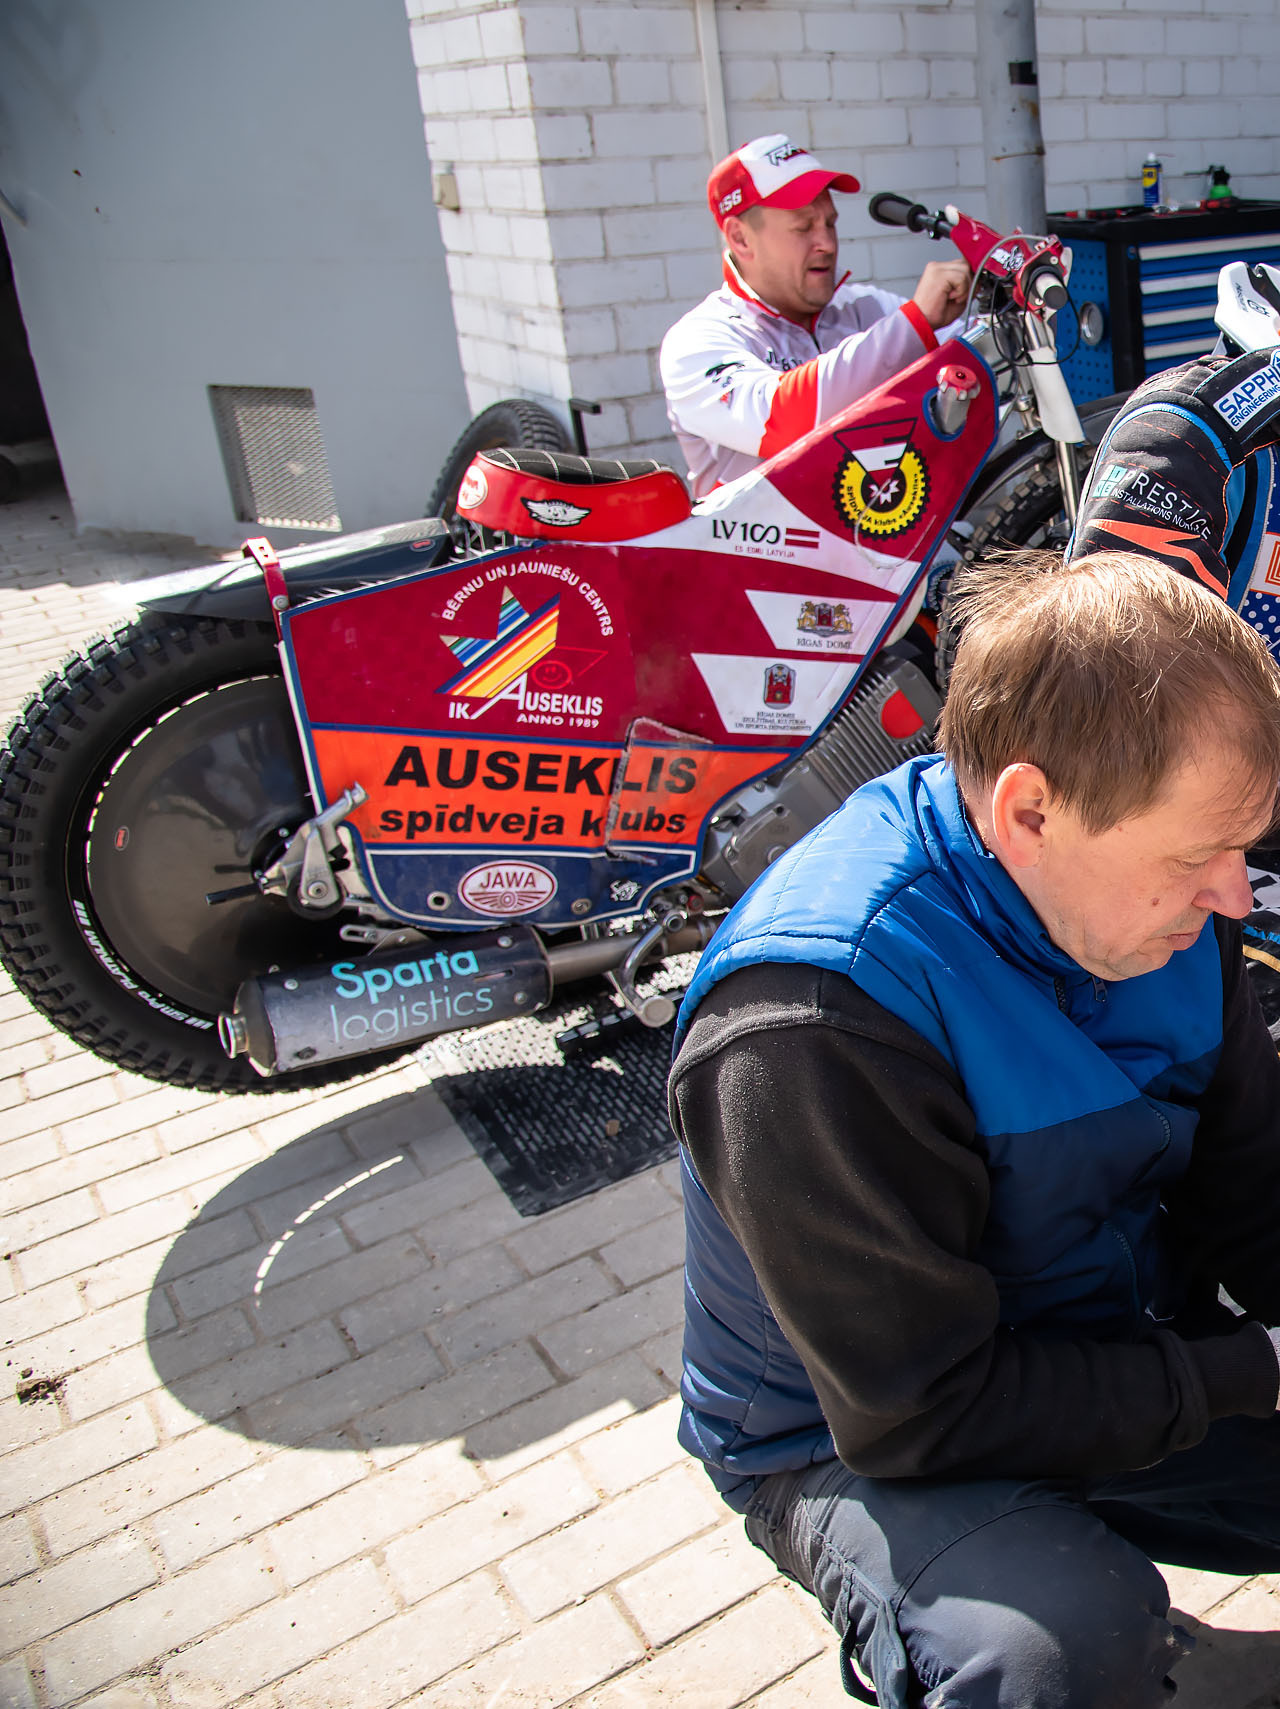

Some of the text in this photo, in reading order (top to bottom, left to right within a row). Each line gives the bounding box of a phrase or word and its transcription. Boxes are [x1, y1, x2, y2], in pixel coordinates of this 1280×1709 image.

[485, 564, 508, 582] UN
[509, 560, 581, 586] JAUNIEŠU
[578, 581, 614, 637] CENTRS
[448, 672, 604, 720] IK AUSEKLIS
[516, 712, 600, 729] ANNO 1989
[383, 745, 698, 797] AUSEKLIS
[379, 803, 565, 842] spīdveja
[479, 871, 537, 889] JAWA
[331, 950, 480, 1005] Sparta
[329, 985, 494, 1044] logistics
